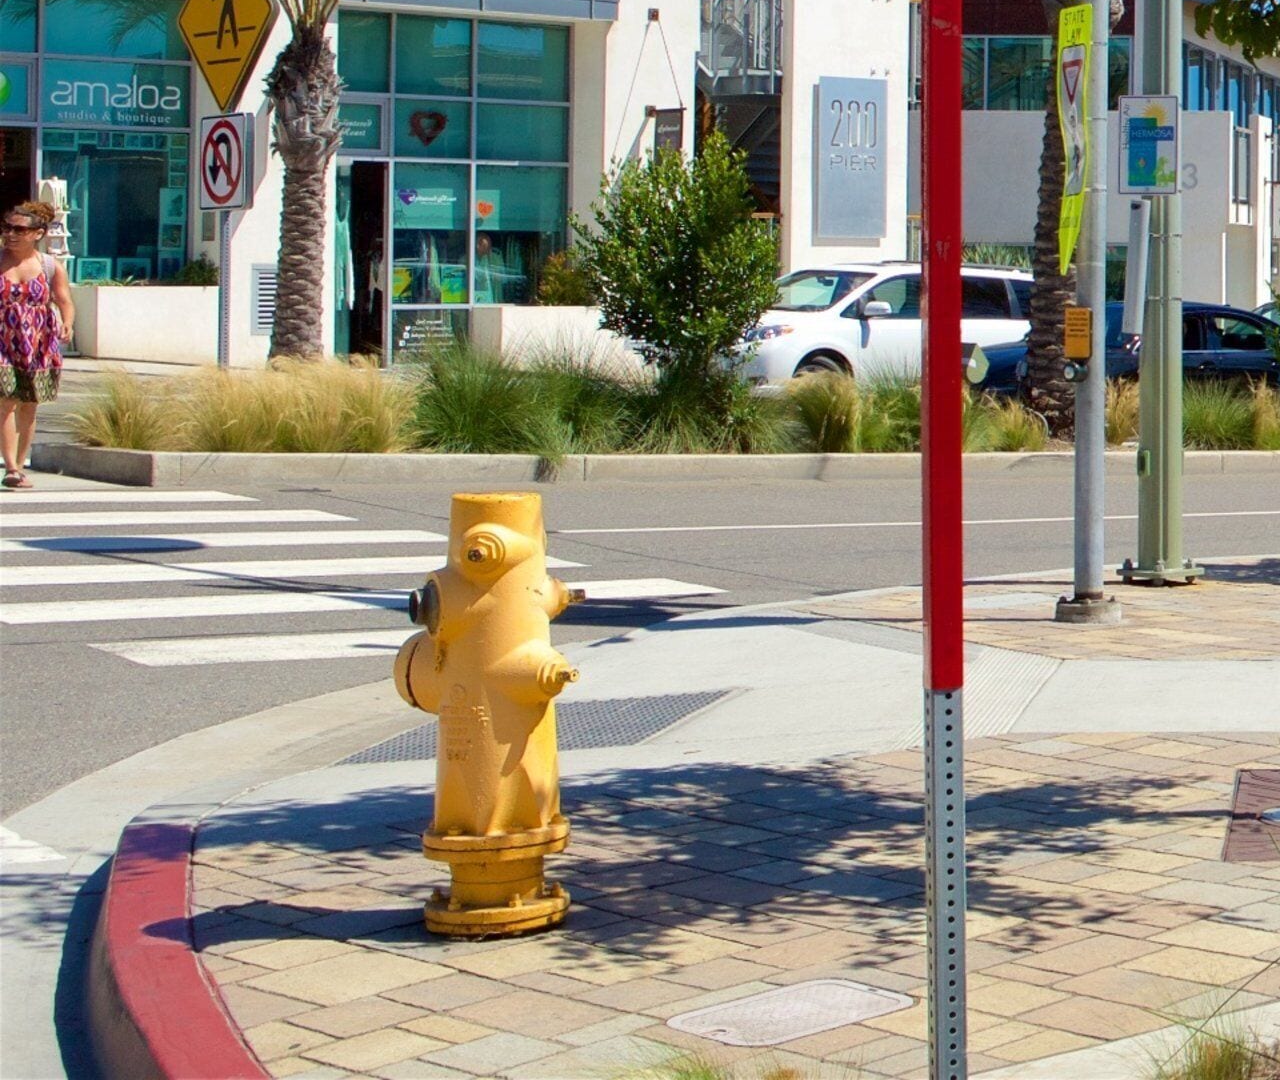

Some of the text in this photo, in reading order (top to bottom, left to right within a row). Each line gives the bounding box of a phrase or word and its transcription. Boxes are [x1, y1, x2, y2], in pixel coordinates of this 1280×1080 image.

[1064, 9, 1085, 26] STATE
[1066, 28, 1082, 44] LAW
[51, 74, 181, 111] amaloa
[57, 110, 172, 125] studio & boutique
[830, 99, 878, 149] 200
[1131, 128, 1173, 139] HERMOSA
[829, 154, 878, 171] PIER
